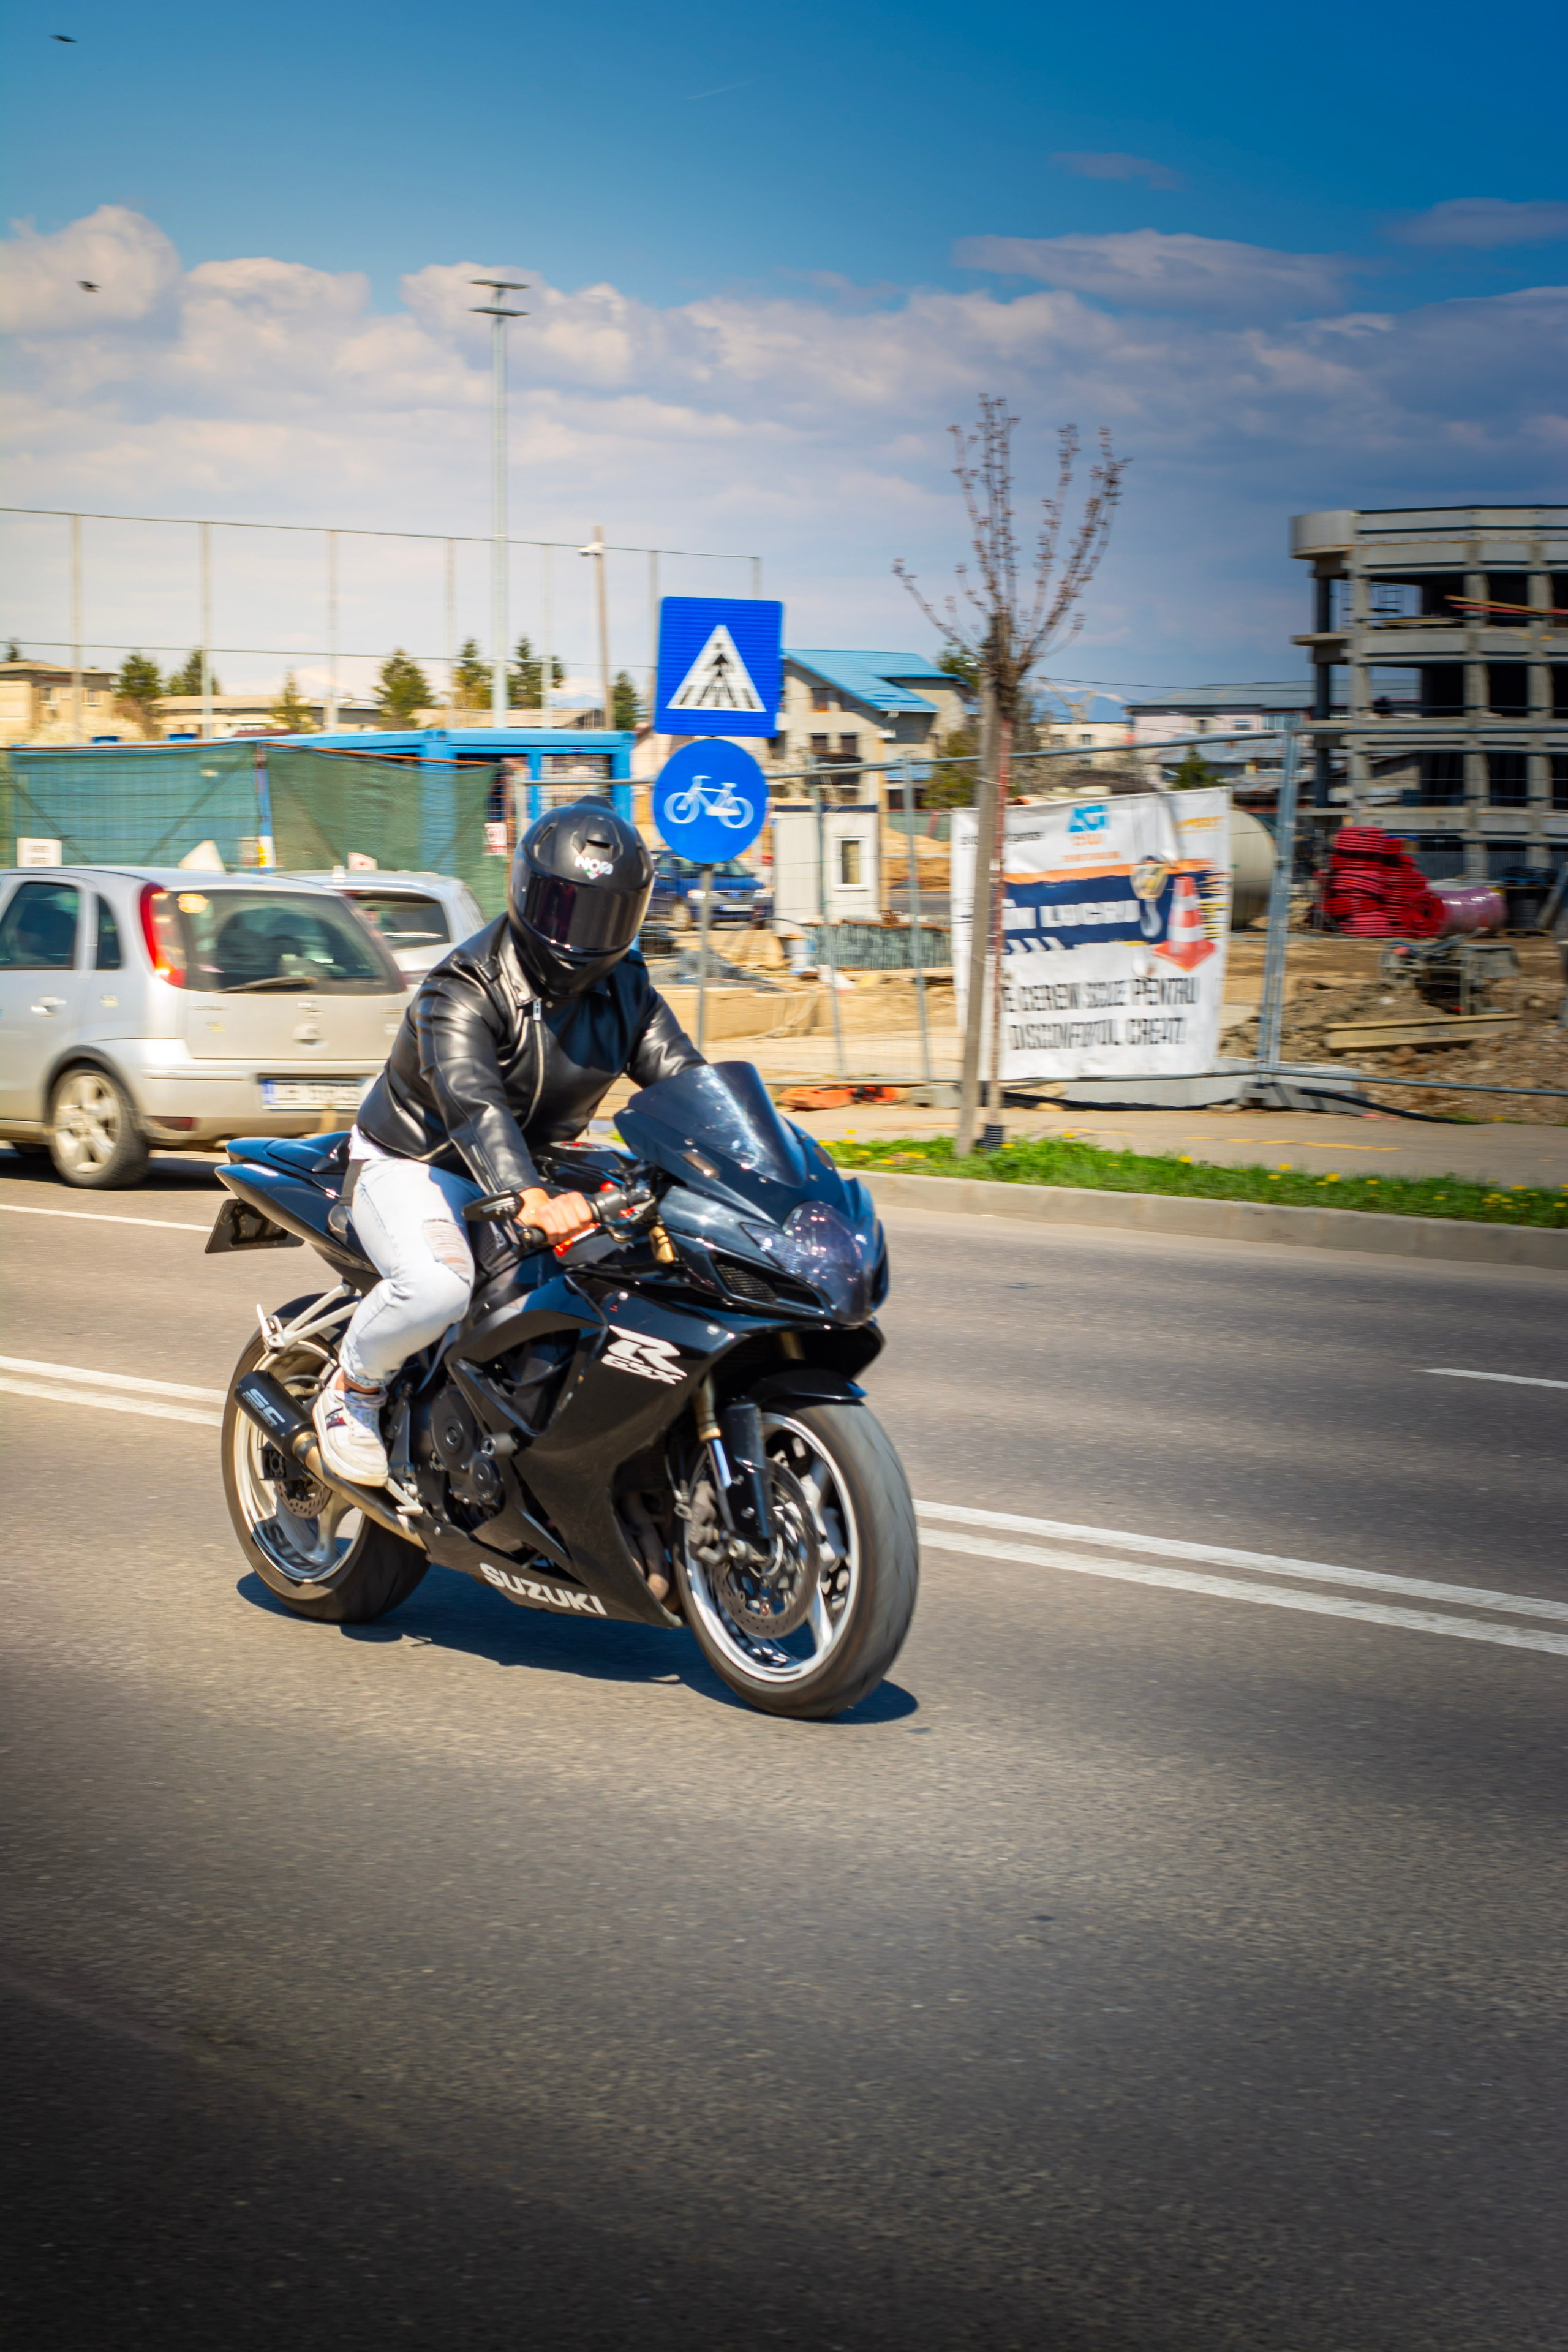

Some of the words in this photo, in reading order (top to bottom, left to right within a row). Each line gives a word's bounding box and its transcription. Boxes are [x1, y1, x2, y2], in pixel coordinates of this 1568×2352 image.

[601, 1353, 683, 1385] GSX
[245, 1388, 286, 1426] SC
[479, 1562, 608, 1616] SUZUKI
